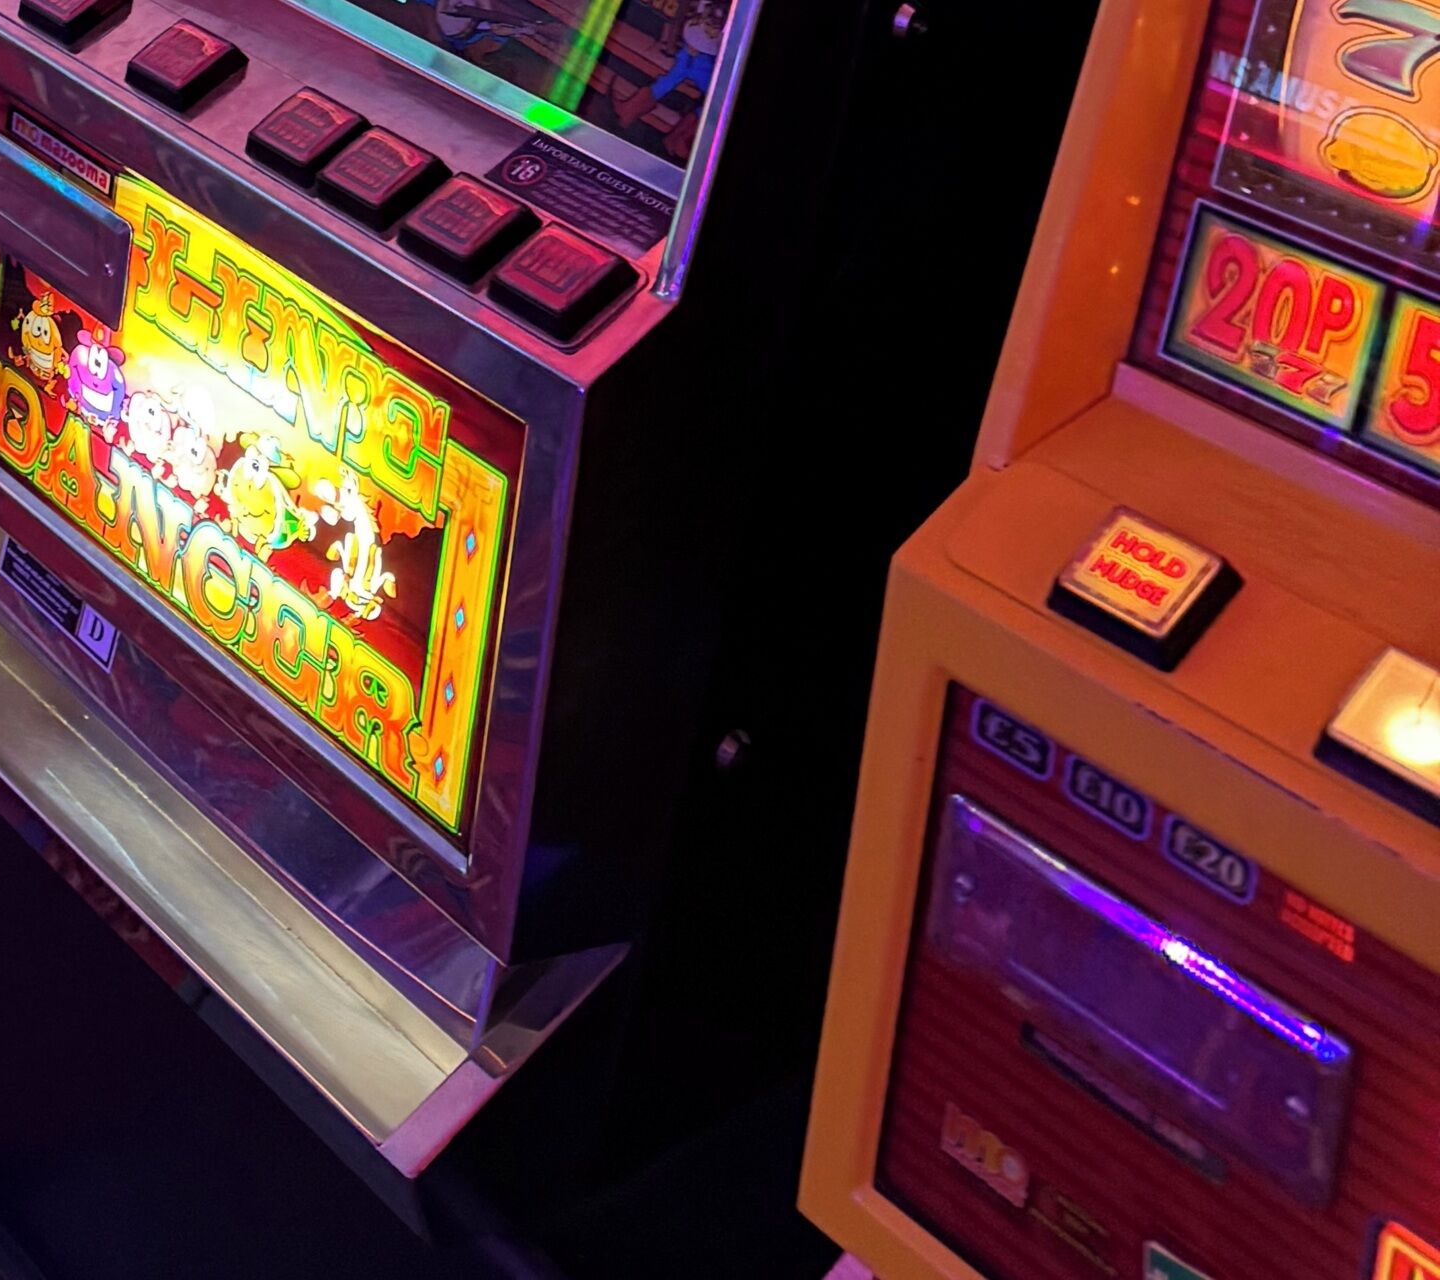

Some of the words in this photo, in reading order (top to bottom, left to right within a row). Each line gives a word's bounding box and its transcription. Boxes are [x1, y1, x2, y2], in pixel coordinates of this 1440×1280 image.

[40, 134, 109, 190] mazooma
[531, 138, 597, 176] IMPORTANT
[596, 170, 634, 196] GUEST
[1189, 232, 1359, 360] 20P
[132, 202, 453, 523] LINE
[1089, 554, 1170, 607] NUDGE
[1110, 530, 1187, 580] HOLD
[89, 615, 105, 642] D
[981, 711, 1042, 766] £5
[1075, 766, 1143, 825] £10
[1171, 822, 1247, 892] £20
